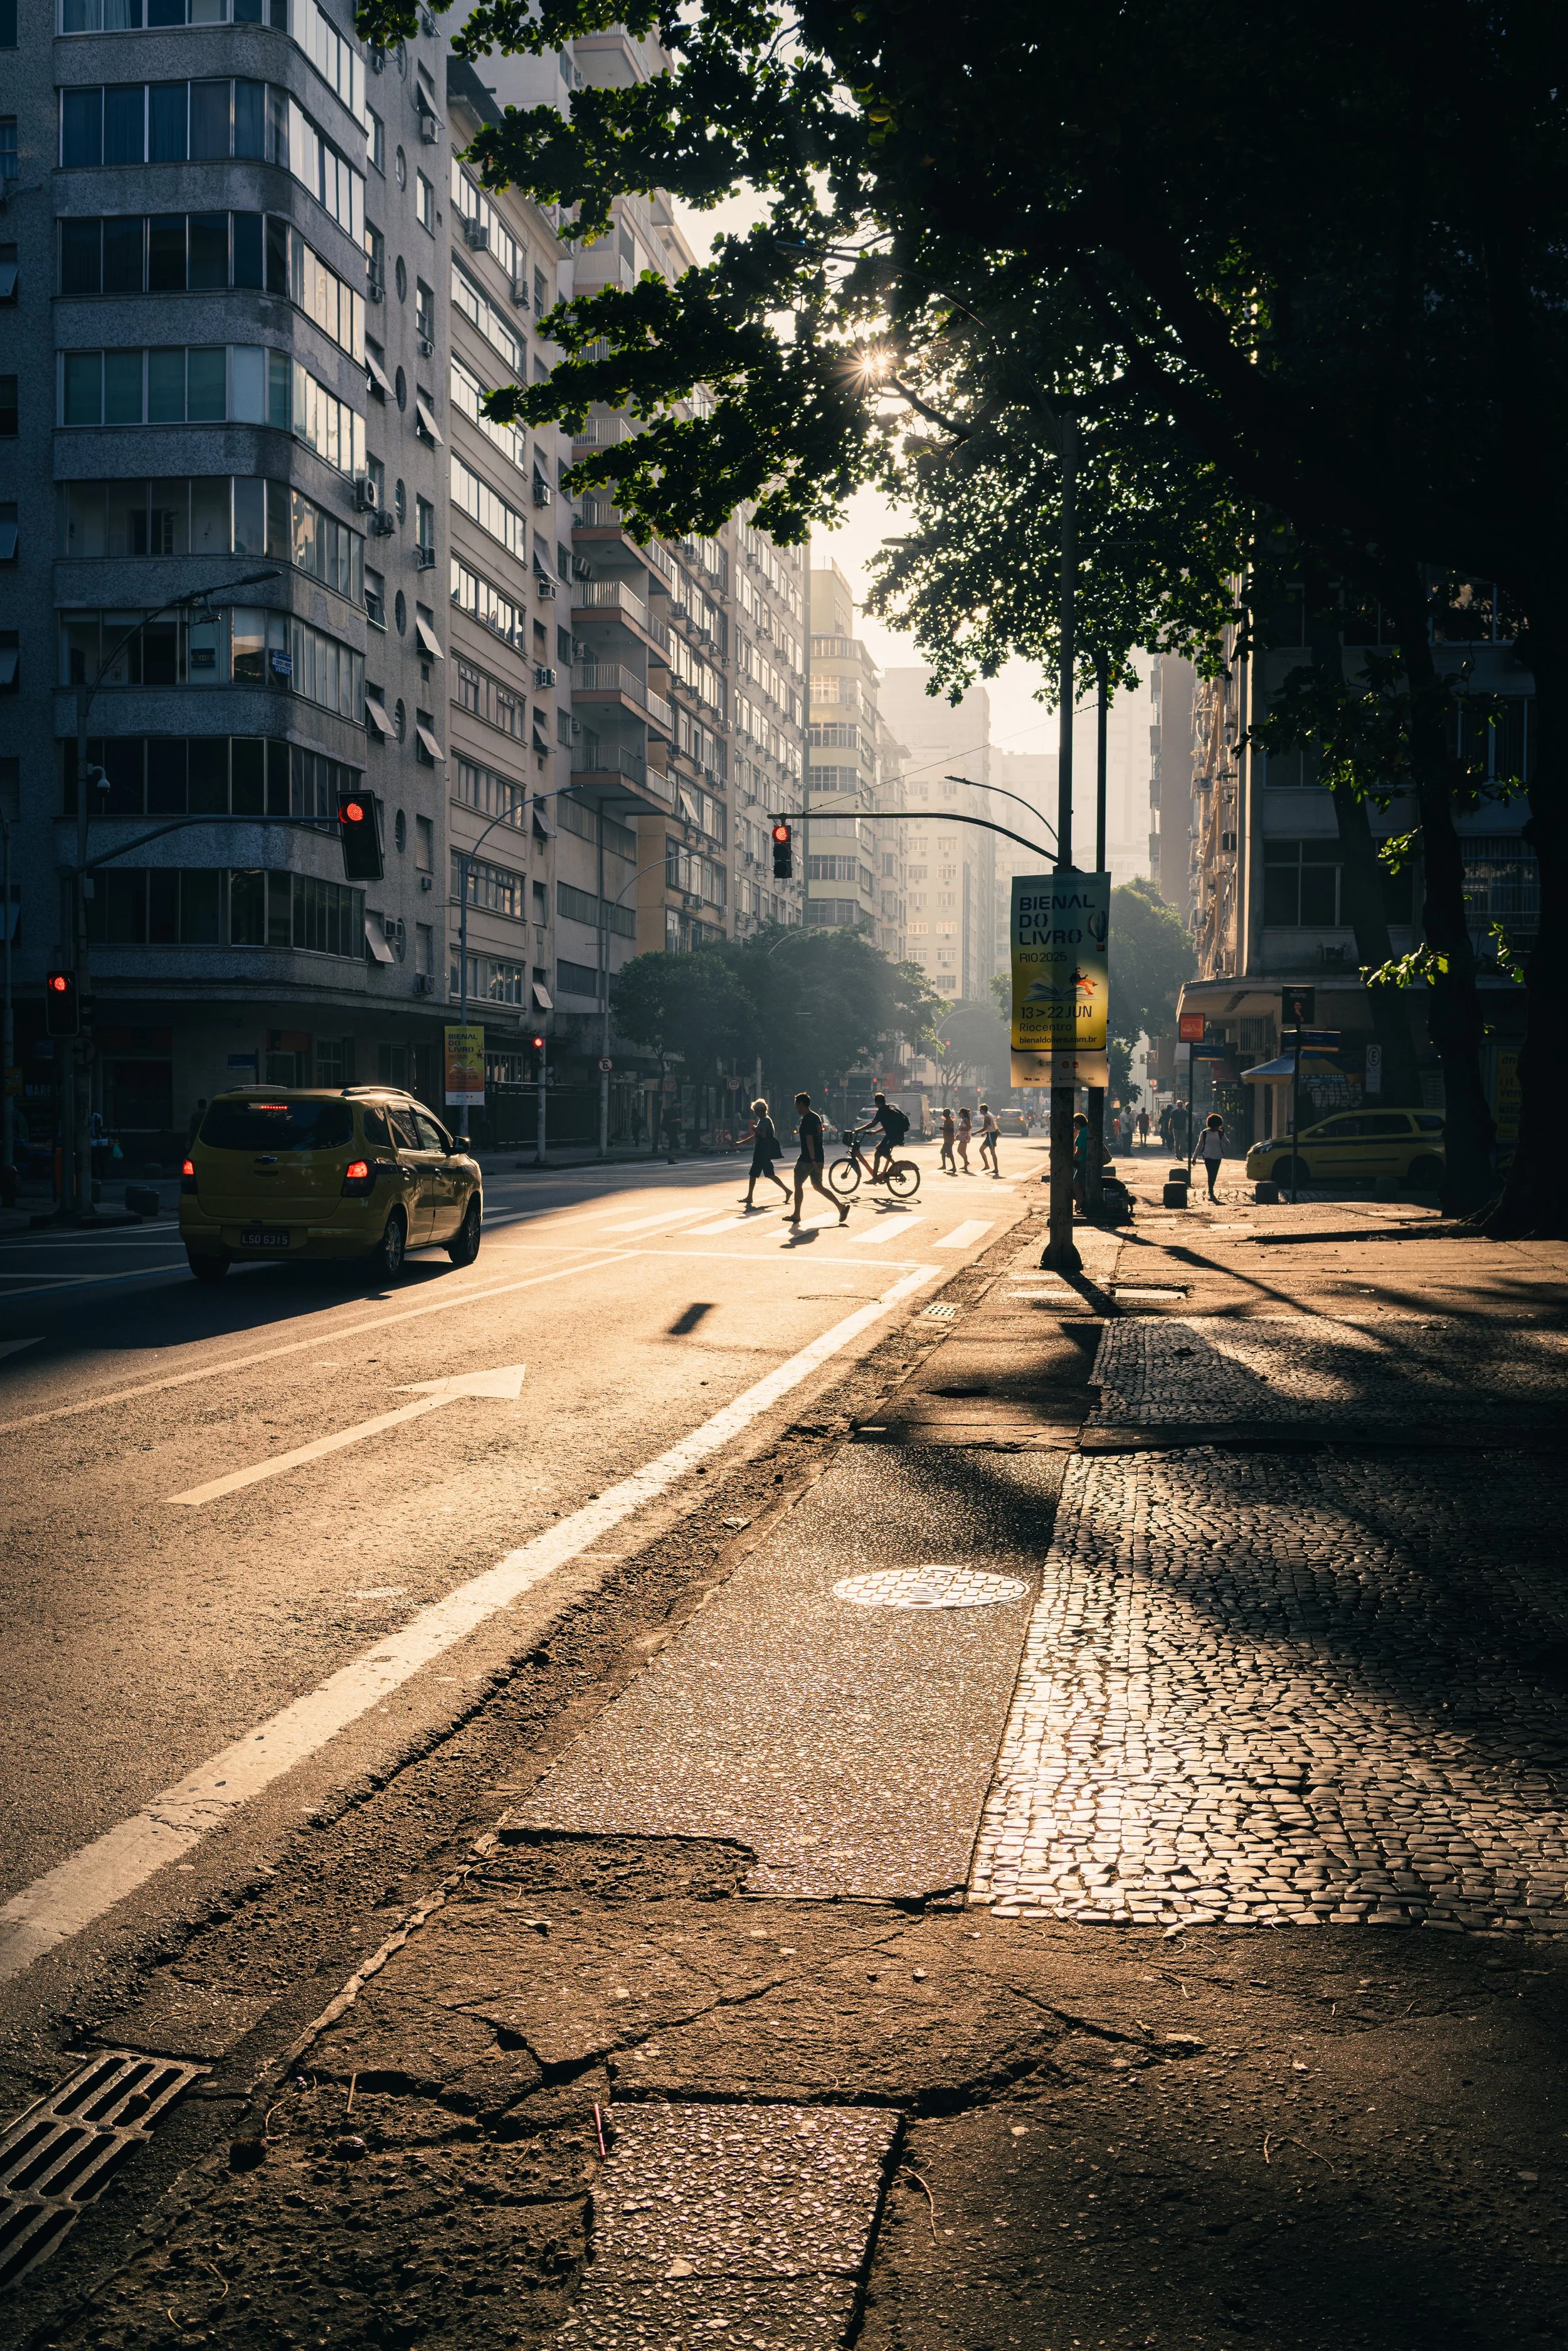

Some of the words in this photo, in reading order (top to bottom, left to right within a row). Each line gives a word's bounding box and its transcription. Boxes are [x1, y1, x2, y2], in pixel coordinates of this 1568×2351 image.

[276, 666, 291, 675] VENDE
[1020, 894, 1096, 911] BIENAL
[1019, 953, 1038, 963] RIO
[1039, 952, 1067, 962] 2025
[1021, 1007, 1034, 1019] 13
[1047, 1006, 1063, 1019] 22
[1065, 1005, 1092, 1019] JUN
[1019, 1022, 1073, 1032] Riocentro
[1019, 1036, 1097, 1044] bienaldolivro.com.br
[263, 1235, 288, 1244] 6315
